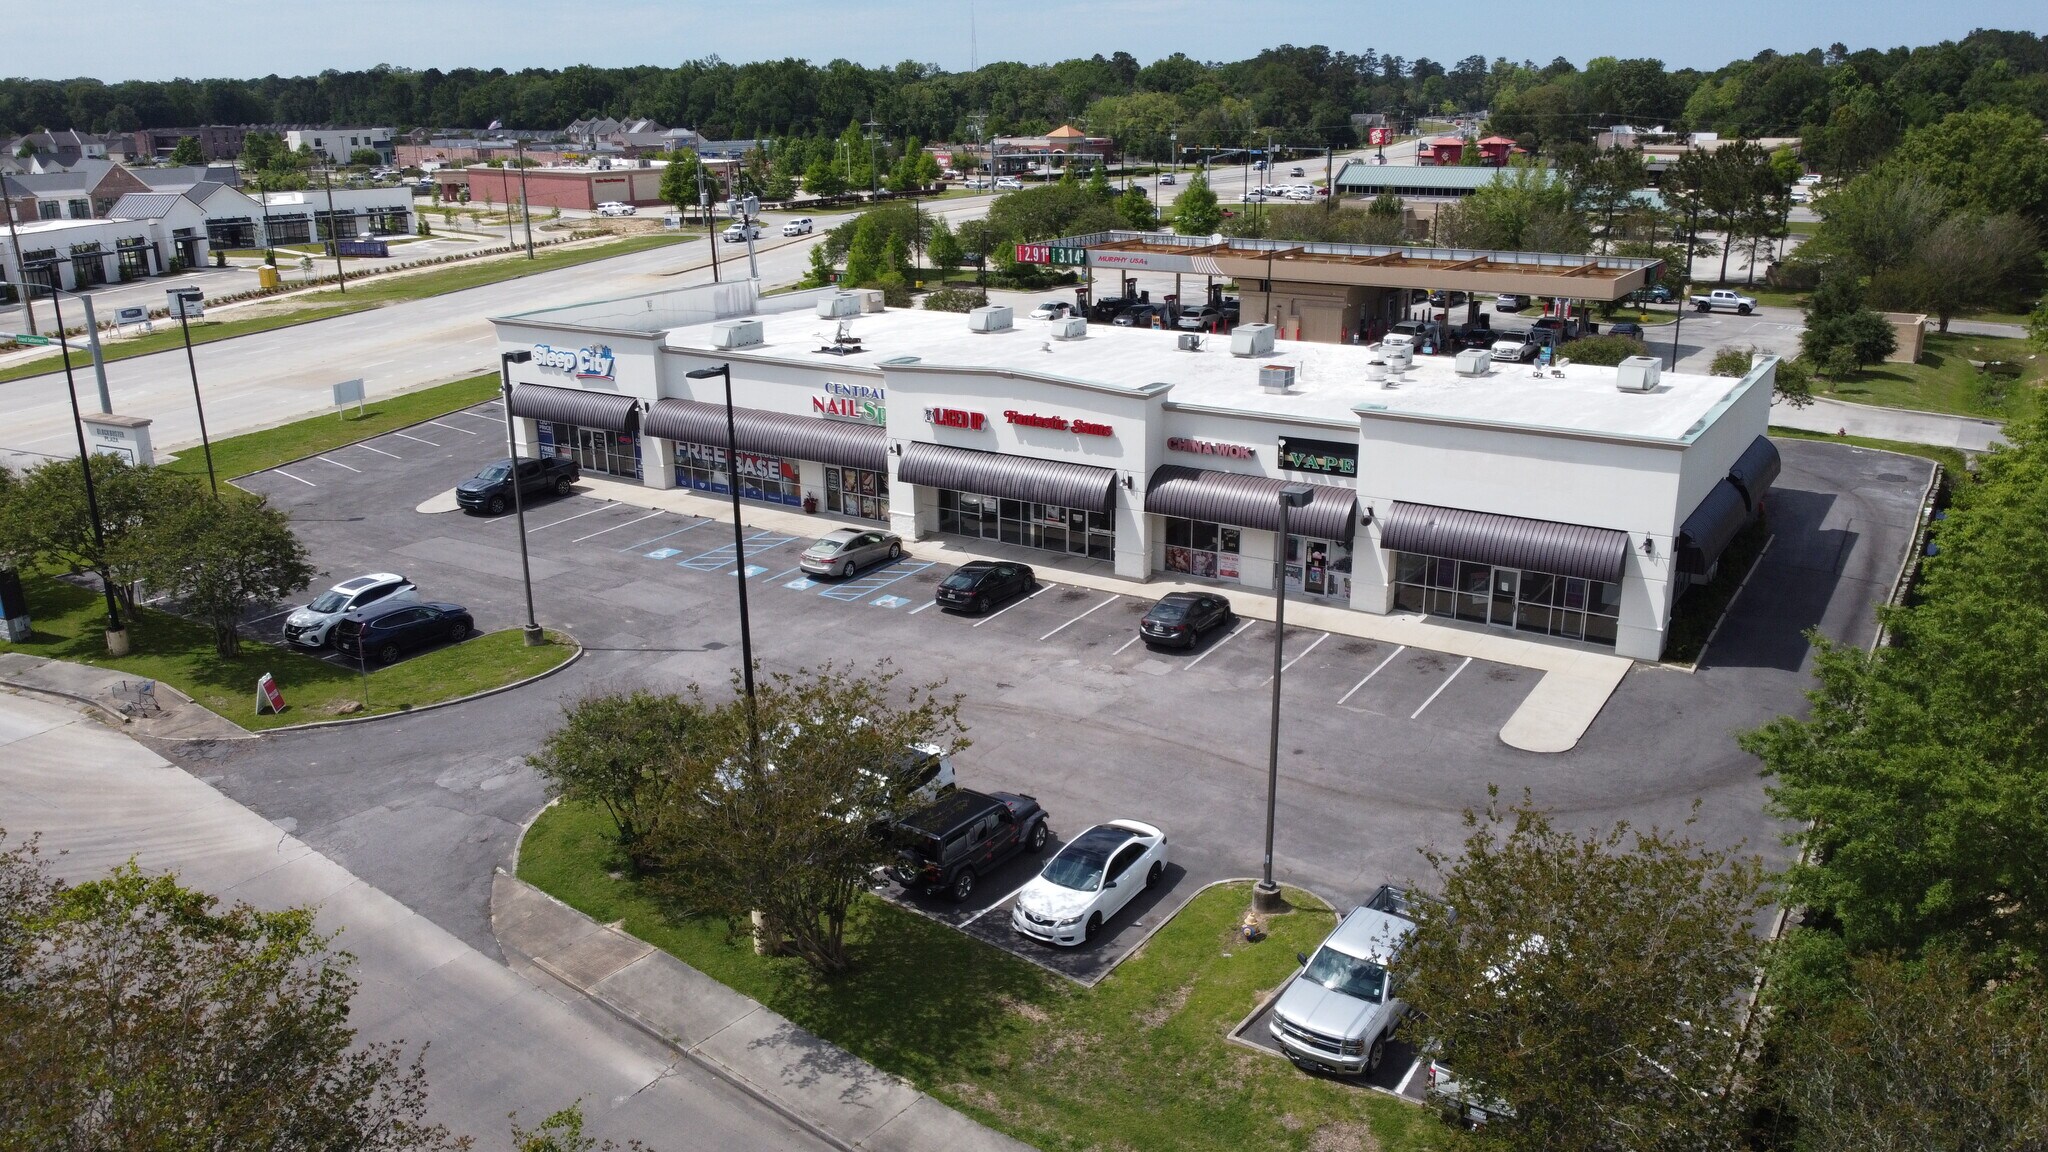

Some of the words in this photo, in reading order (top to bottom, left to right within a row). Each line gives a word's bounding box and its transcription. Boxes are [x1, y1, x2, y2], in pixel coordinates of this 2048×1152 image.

[1097, 255, 1128, 264] MURPHY
[532, 344, 577, 373] Sleep
[579, 347, 614, 377] City
[812, 396, 860, 418] NAIL
[934, 407, 969, 429] LACED
[970, 411, 986, 431] UP
[1003, 410, 1068, 431] Fantastic
[1071, 419, 1113, 437] Sams
[675, 440, 726, 464] FREE
[1167, 436, 1213, 456] CHINA
[1215, 442, 1253, 459] WOK
[1289, 451, 1355, 474] VAPE
